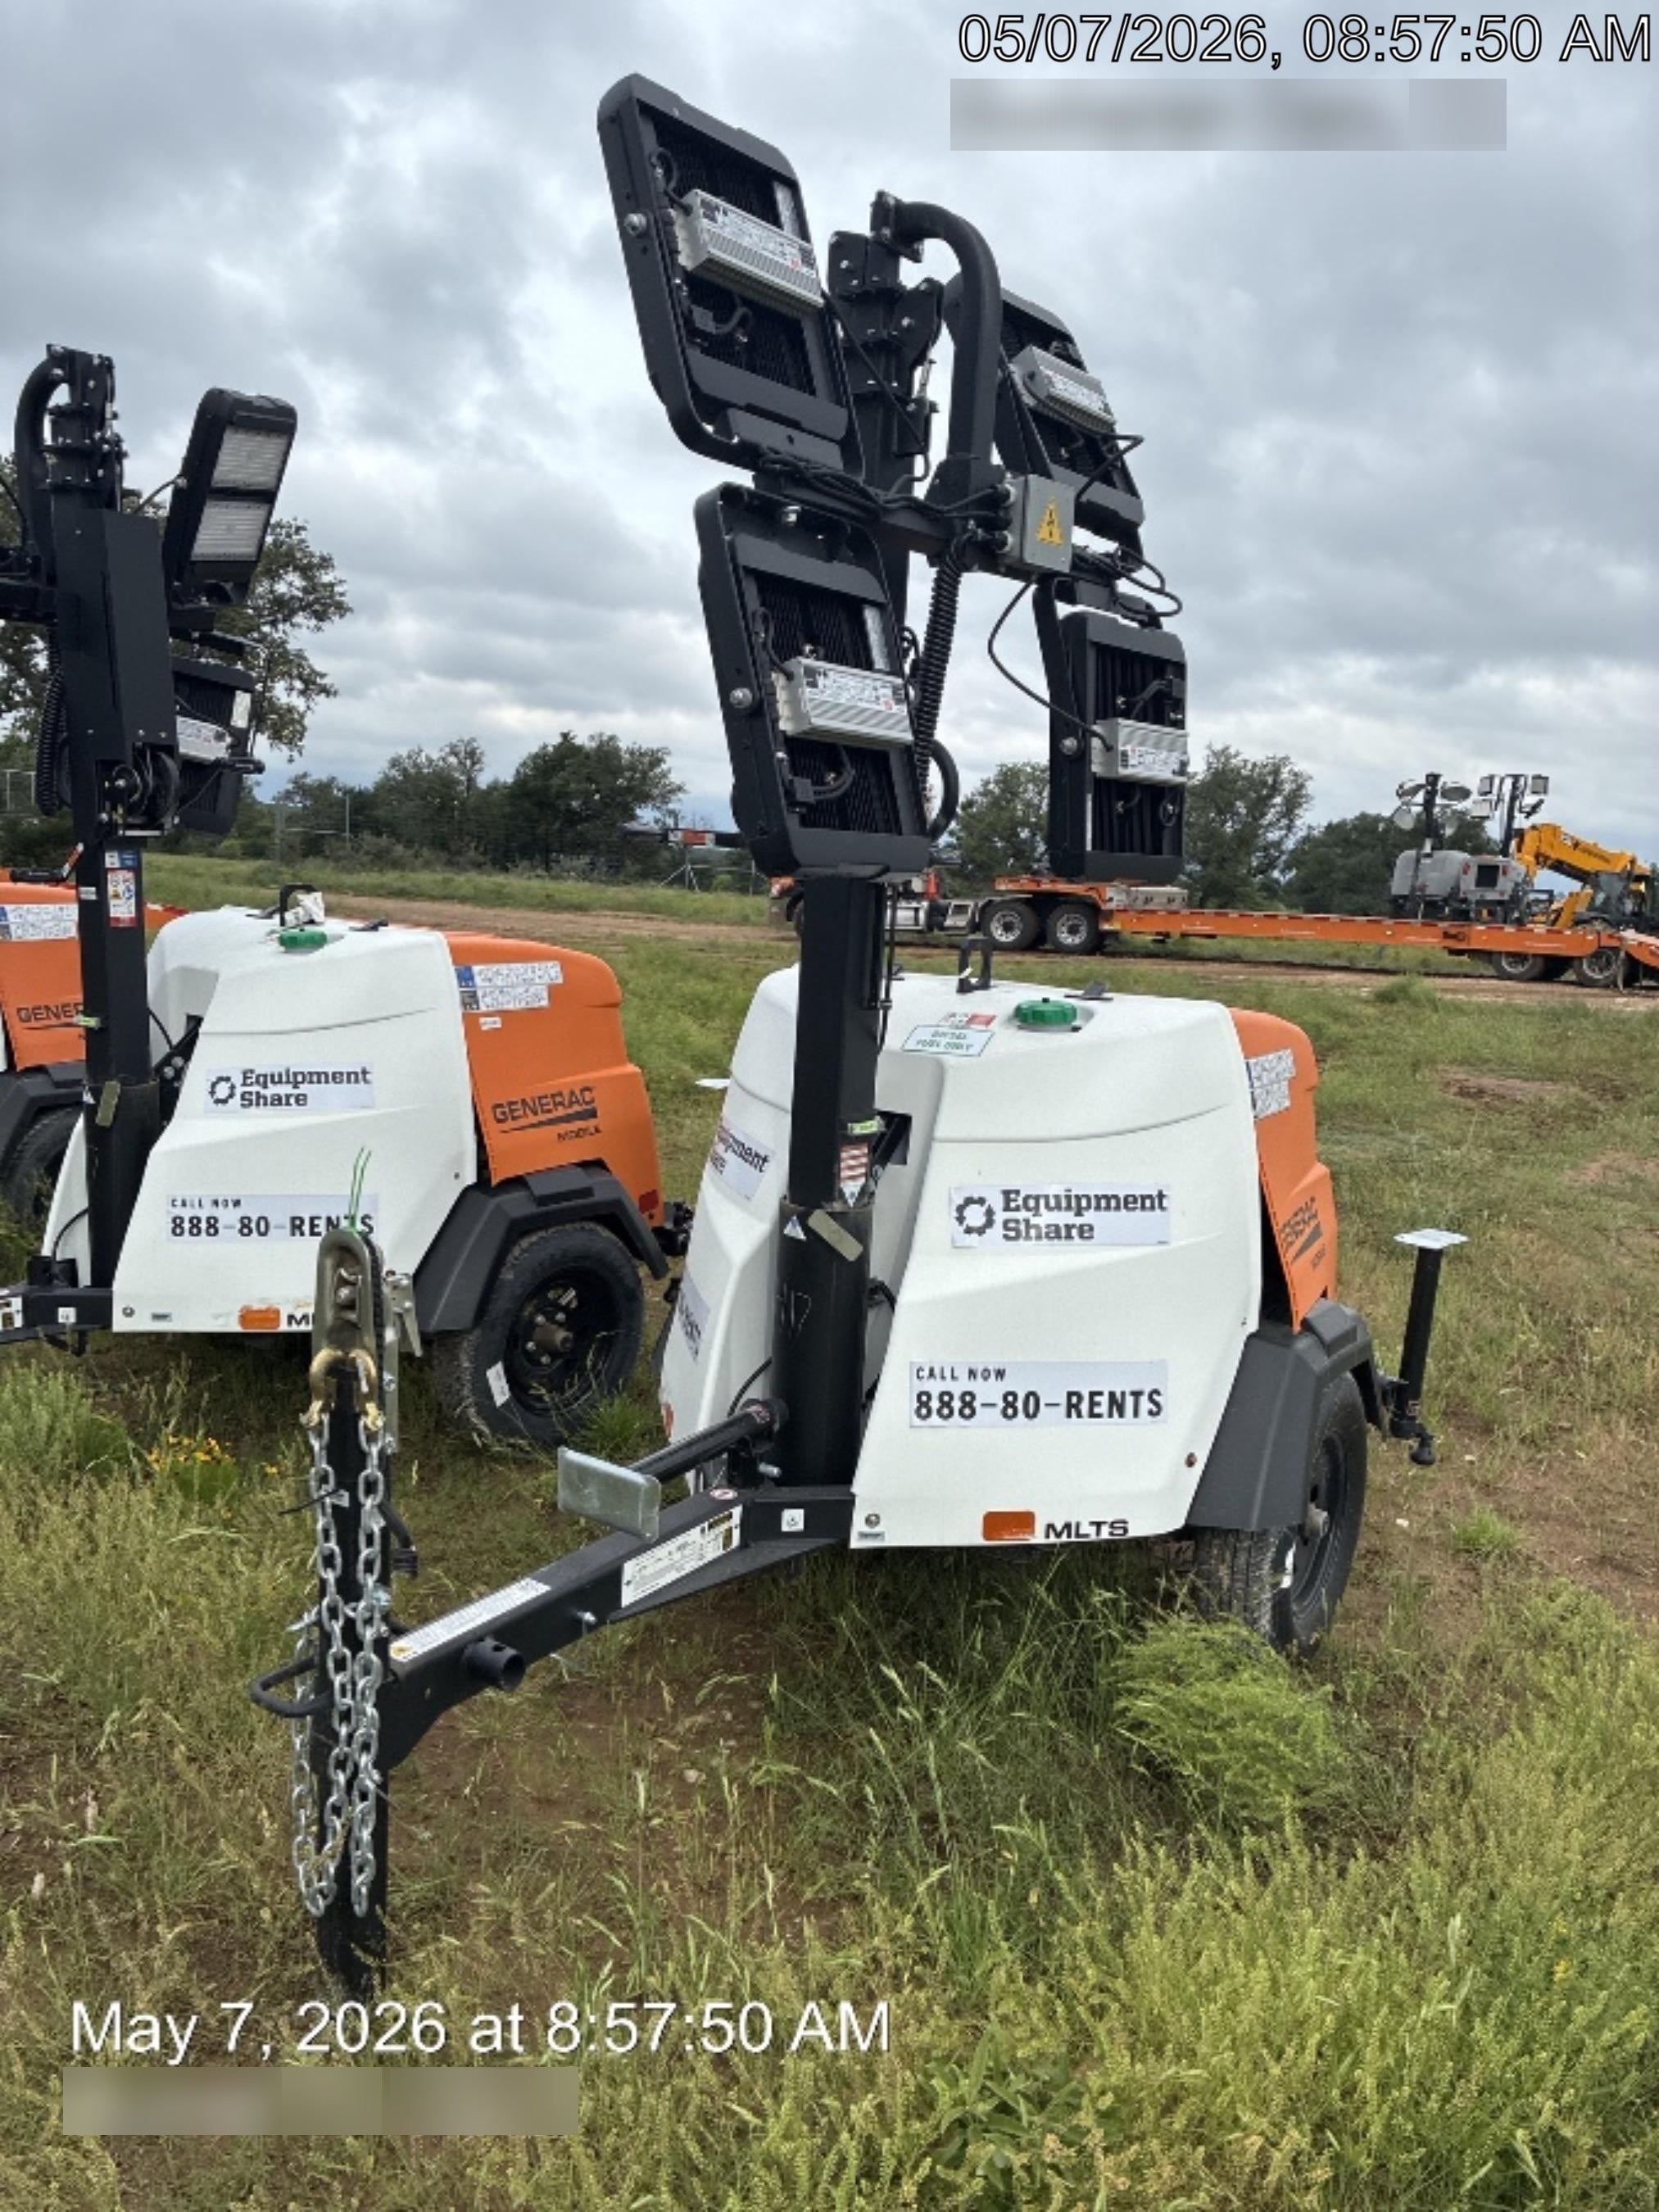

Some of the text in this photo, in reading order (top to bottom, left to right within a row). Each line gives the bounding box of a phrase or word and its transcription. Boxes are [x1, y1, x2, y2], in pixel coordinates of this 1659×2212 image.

[16, 1003, 83, 1022] GENE
[240, 1067, 371, 1089] Equipment
[240, 1090, 308, 1108] Share
[492, 1086, 596, 1124] GENERAC
[170, 1198, 242, 1209] CALL NOW
[1000, 1189, 1168, 1217] Equipment
[1002, 1218, 1095, 1242] Share
[915, 1366, 1007, 1382] CALL NOW
[914, 1388, 1163, 1421] 888-80-RENTS
[1044, 1520, 1129, 1539] MLTS
